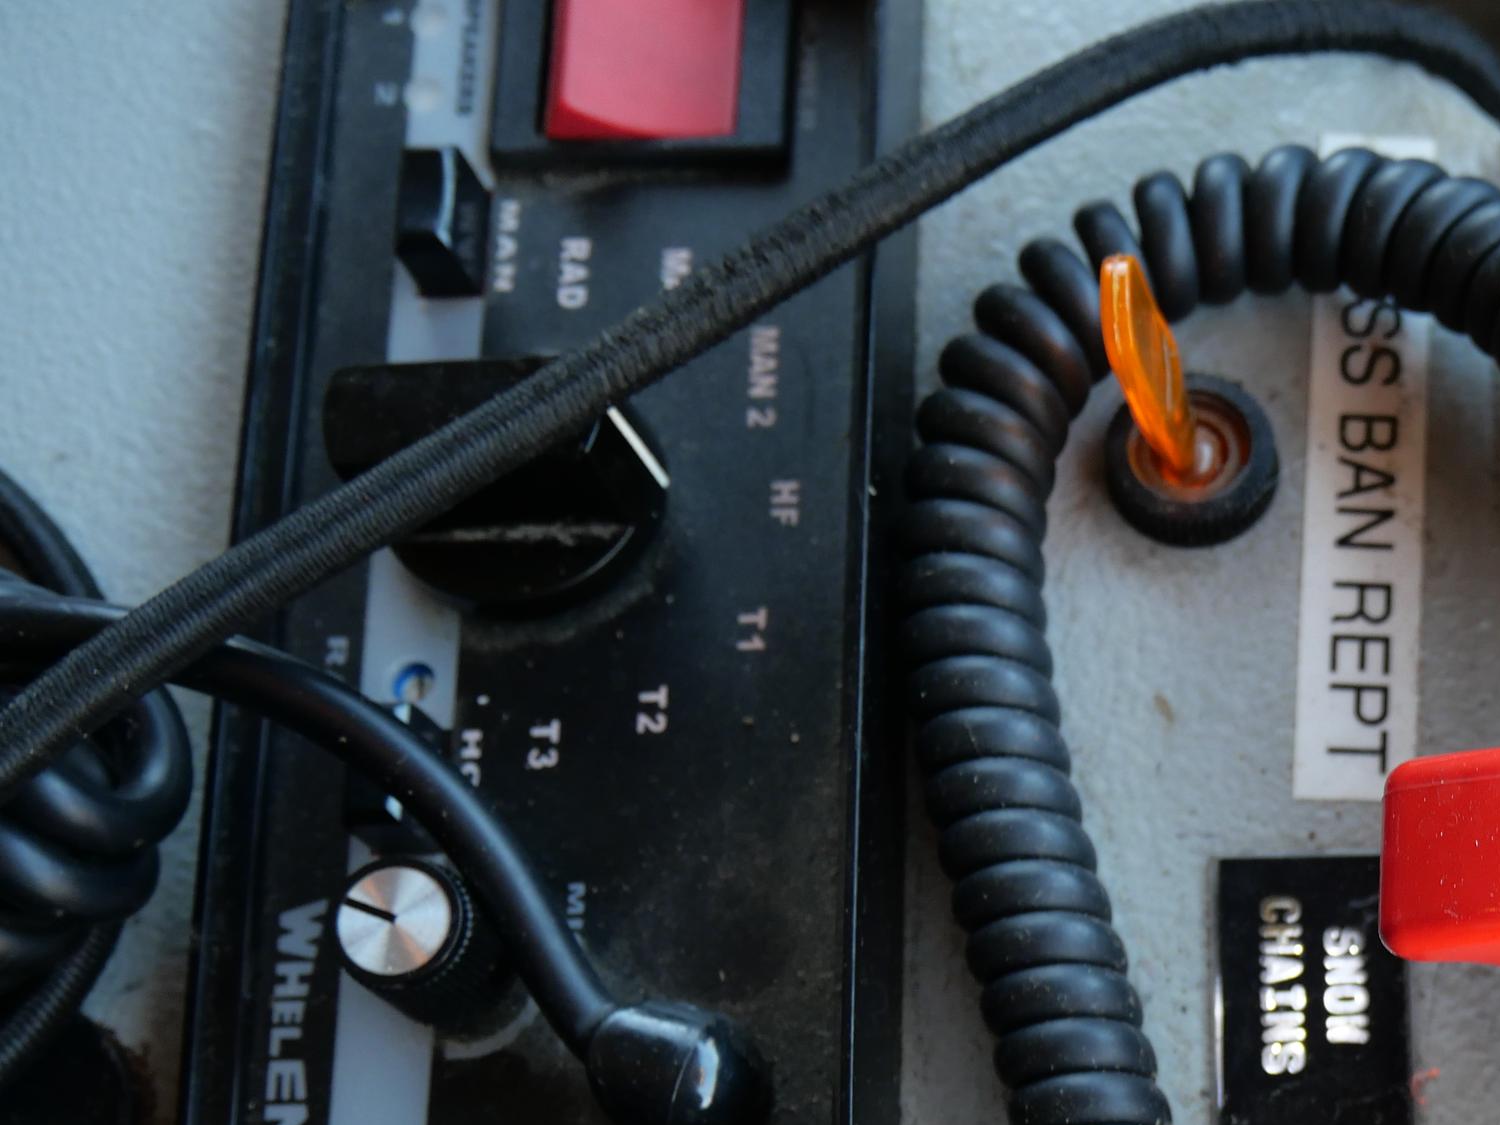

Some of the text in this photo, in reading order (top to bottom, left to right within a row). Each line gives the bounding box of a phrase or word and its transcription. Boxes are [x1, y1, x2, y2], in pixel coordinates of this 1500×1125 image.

[494, 199, 520, 293] MAN
[557, 236, 593, 309] RAD
[745, 325, 781, 429] MAN 2
[769, 480, 801, 528] HF
[1335, 413, 1399, 551] BAN
[736, 607, 768, 652] T1
[635, 684, 670, 734] T2
[1326, 581, 1393, 774] REPT
[526, 719, 561, 770] T3
[1258, 896, 1307, 1076] CHAINS
[1322, 925, 1370, 1046] SNOW
